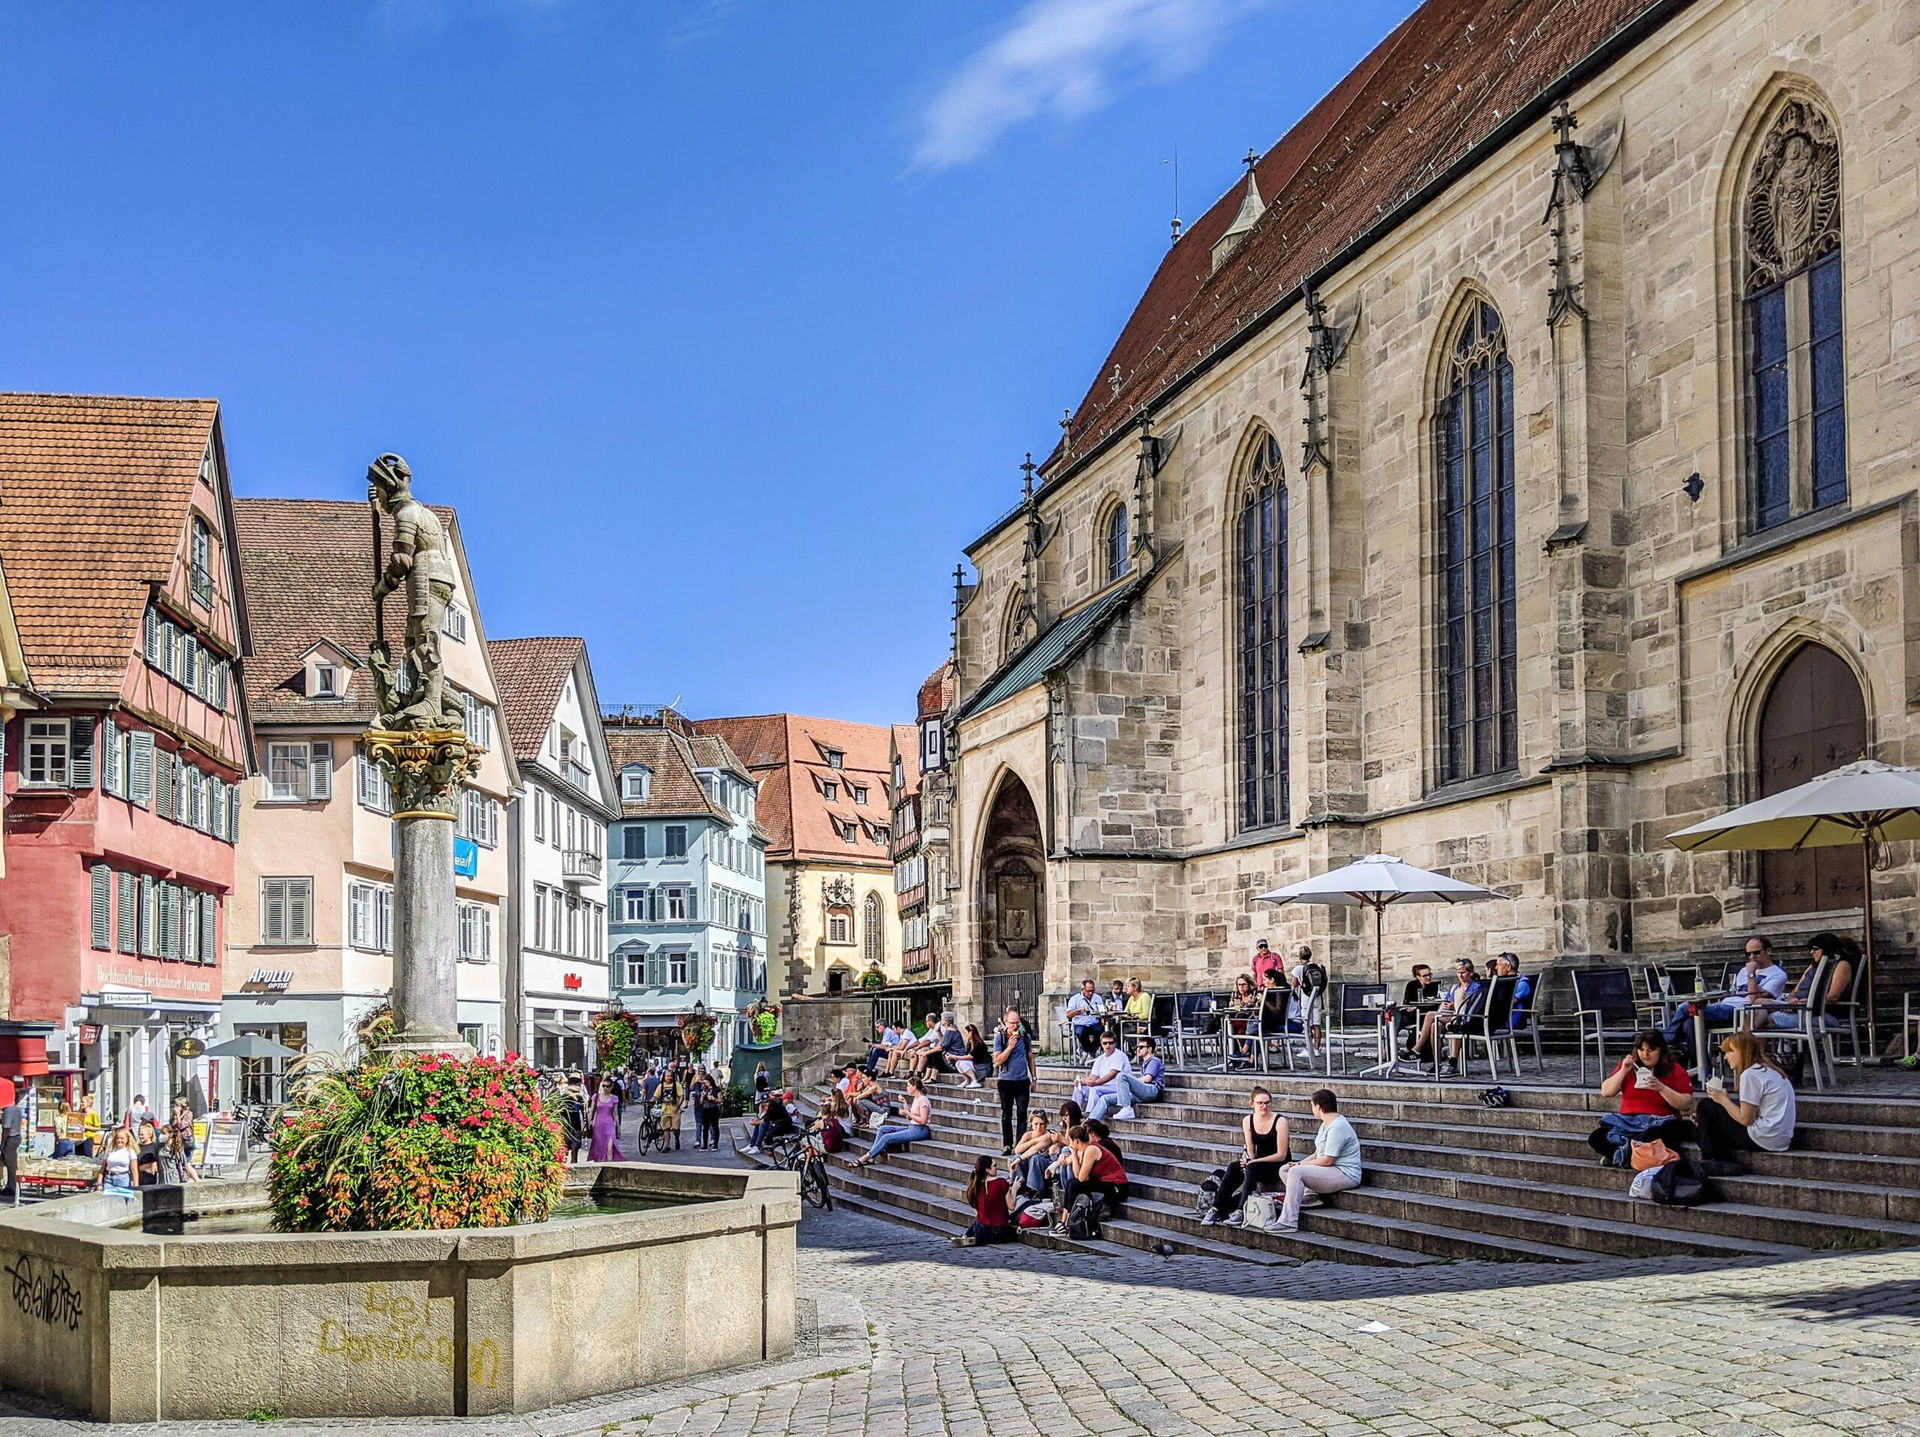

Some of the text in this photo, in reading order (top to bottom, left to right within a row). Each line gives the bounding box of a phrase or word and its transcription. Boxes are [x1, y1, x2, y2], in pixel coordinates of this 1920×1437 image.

[97, 964, 144, 987] Buchhandlung
[145, 971, 181, 989] Heckenhauer
[247, 968, 293, 983] APOLLO
